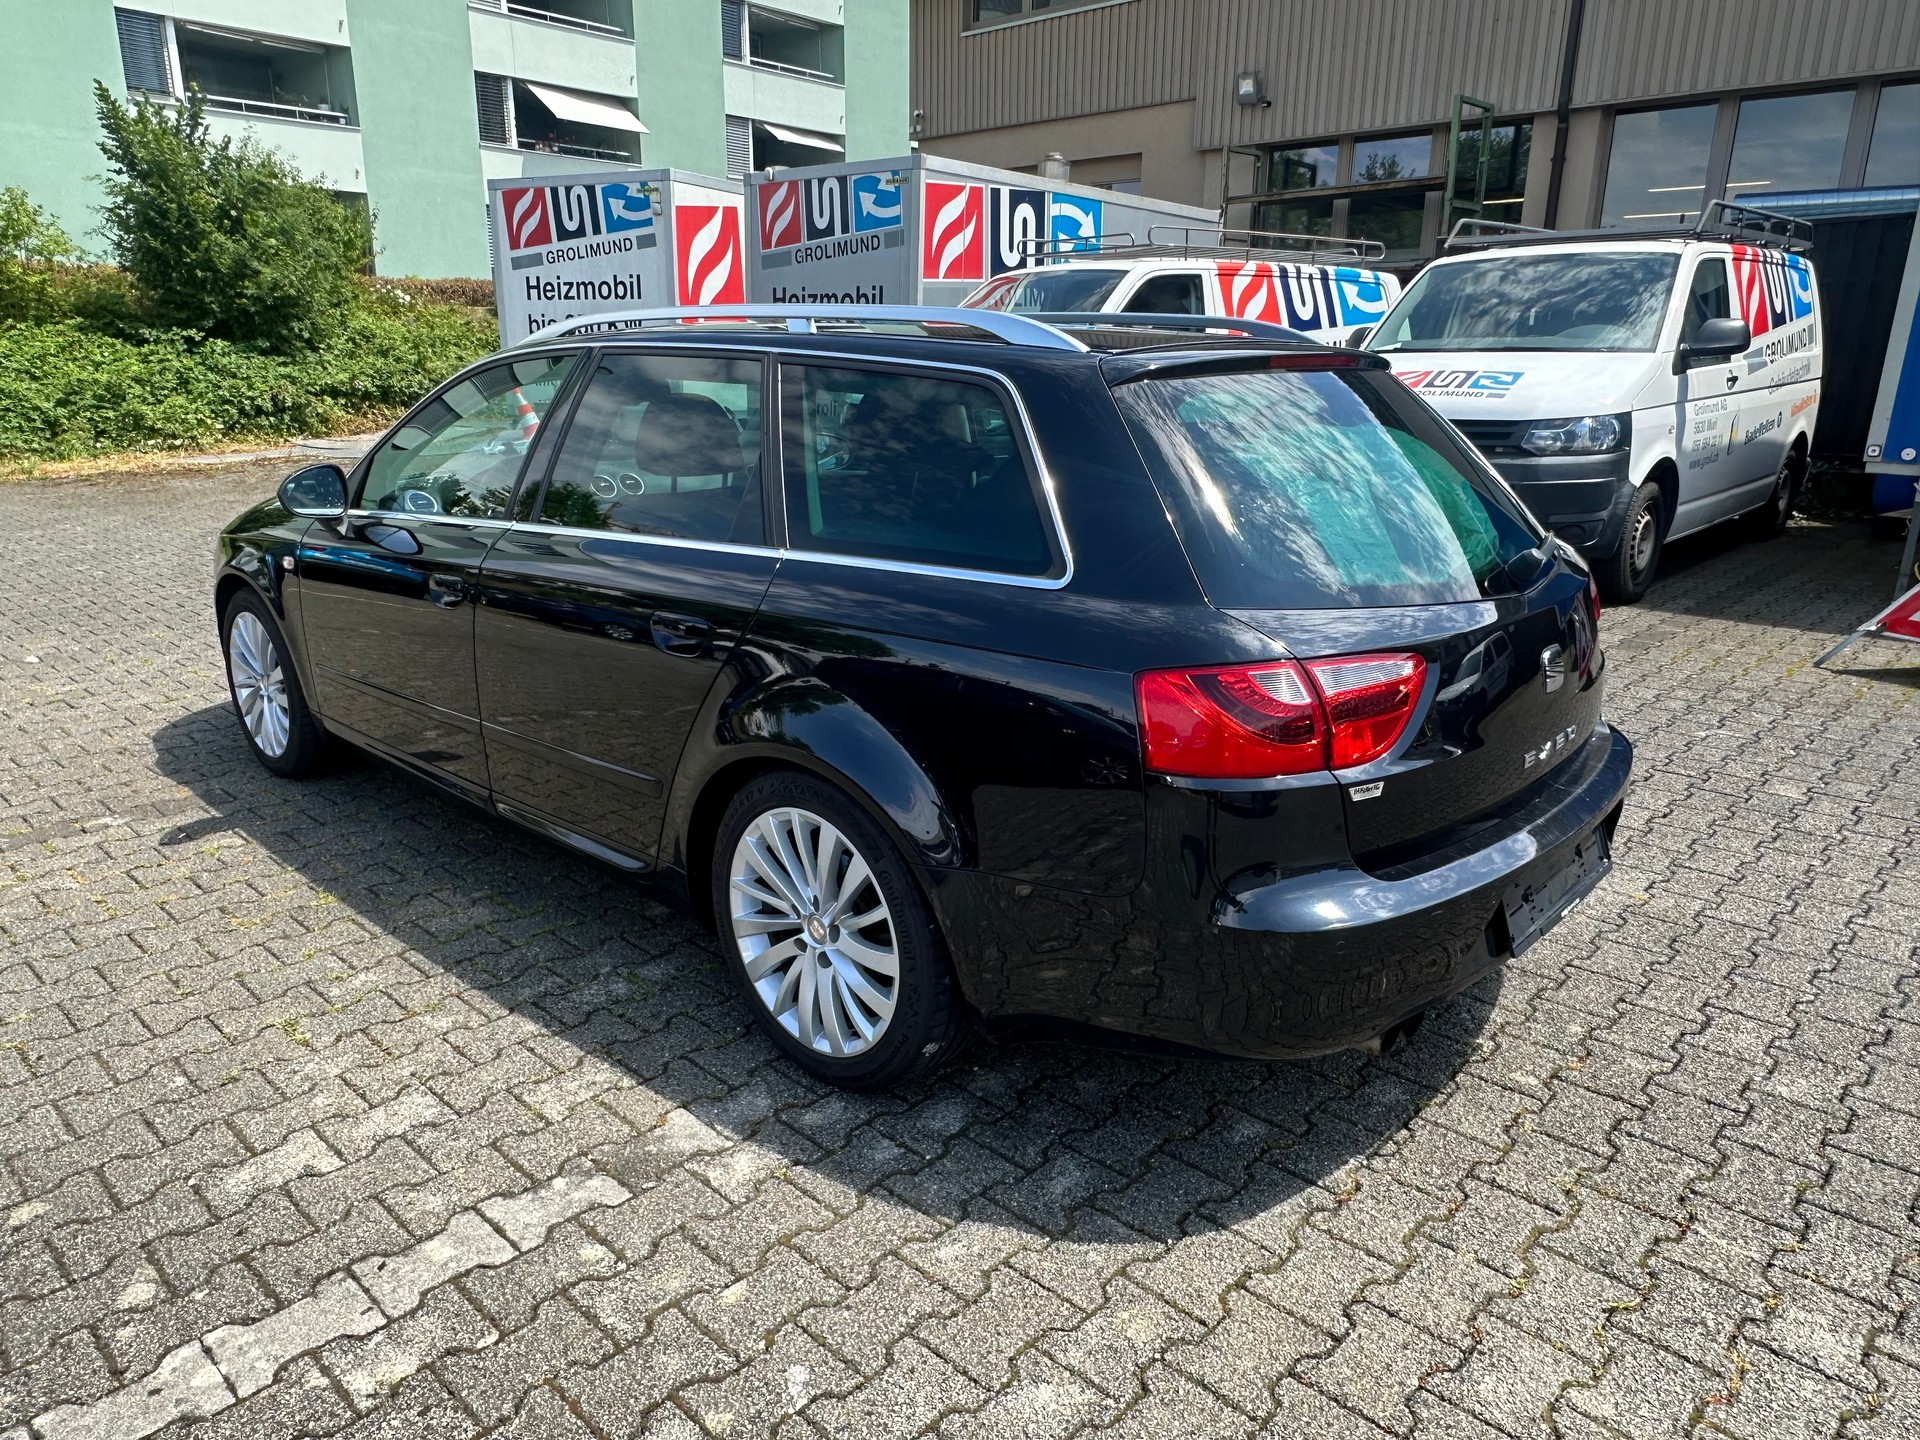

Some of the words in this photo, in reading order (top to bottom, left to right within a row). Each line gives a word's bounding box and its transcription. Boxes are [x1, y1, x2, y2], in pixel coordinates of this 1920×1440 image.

[546, 237, 633, 264] GROLIMUND
[795, 234, 881, 265] GROLIMUND
[525, 274, 642, 300] Heizmobil
[1764, 327, 1808, 364] GROLIMUND
[1417, 390, 1485, 398] OLIMUND
